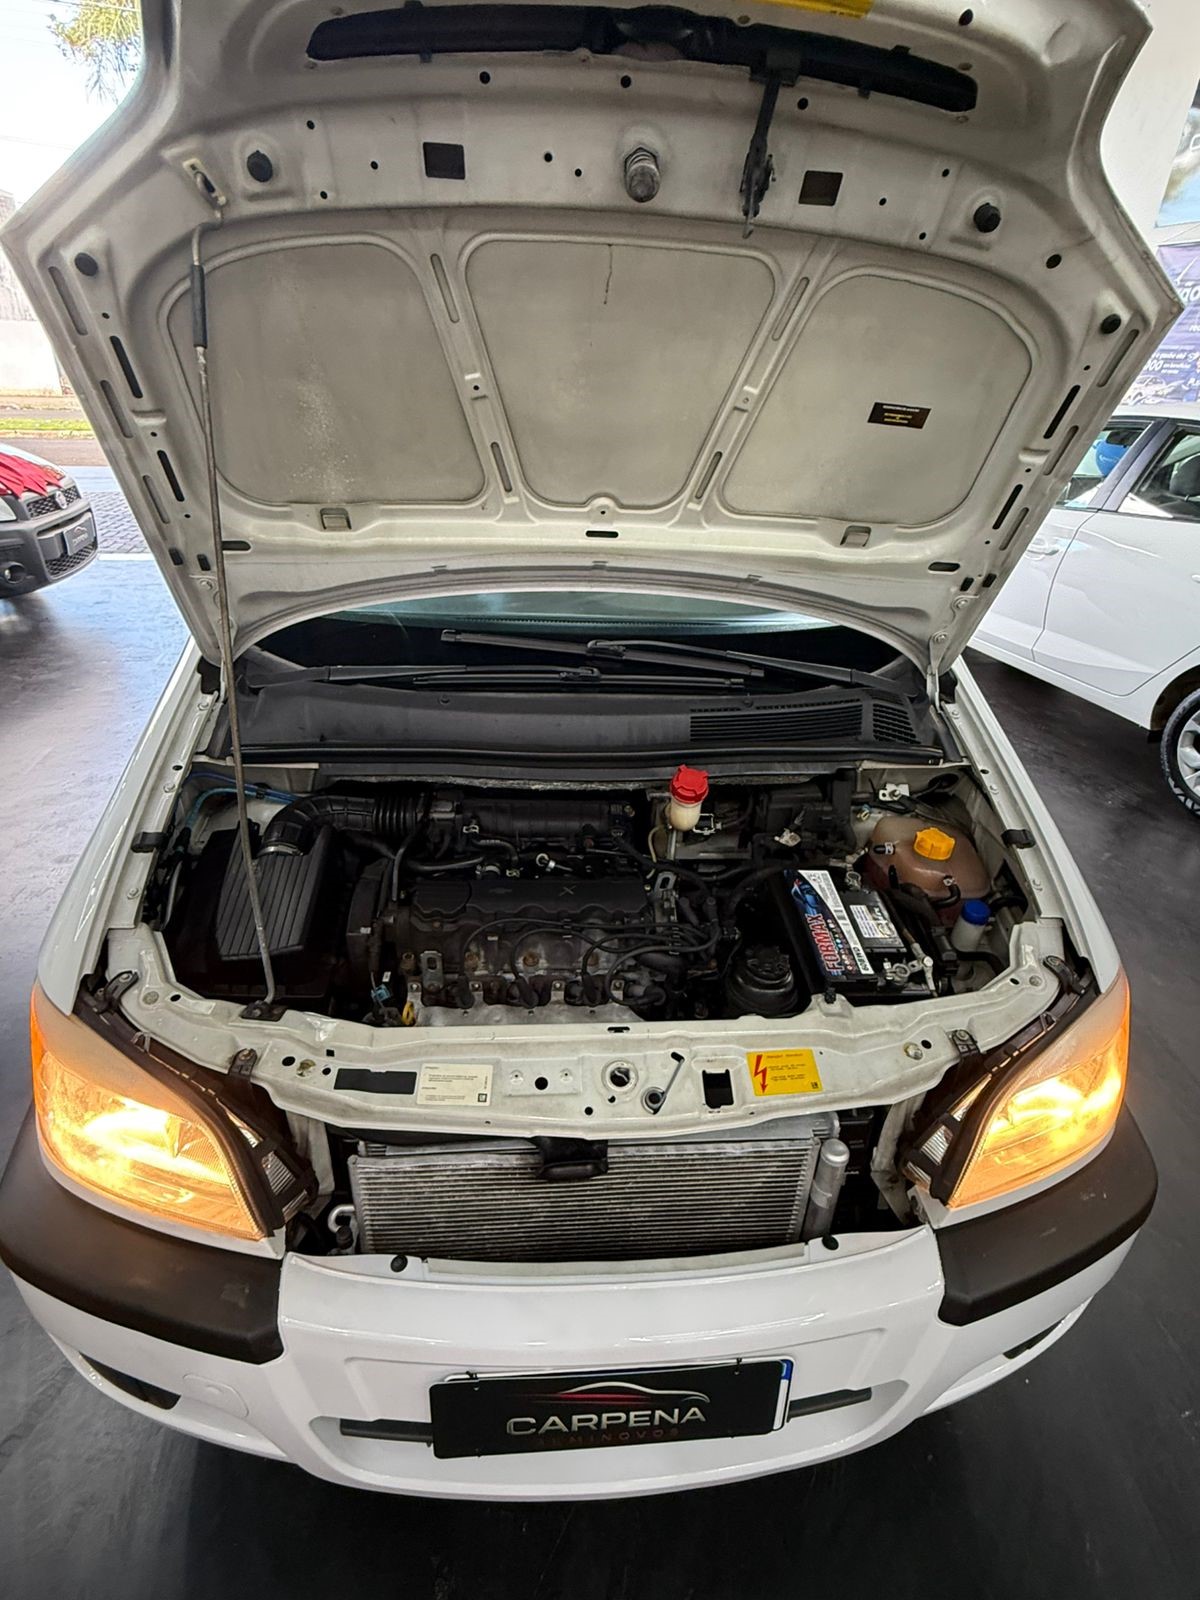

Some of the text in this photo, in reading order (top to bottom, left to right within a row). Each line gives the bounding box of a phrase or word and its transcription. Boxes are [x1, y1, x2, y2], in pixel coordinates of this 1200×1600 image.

[805, 914, 844, 971] FORMAX
[506, 1407, 706, 1435] CARPENA
[537, 1428, 680, 1445] MINOVOS
